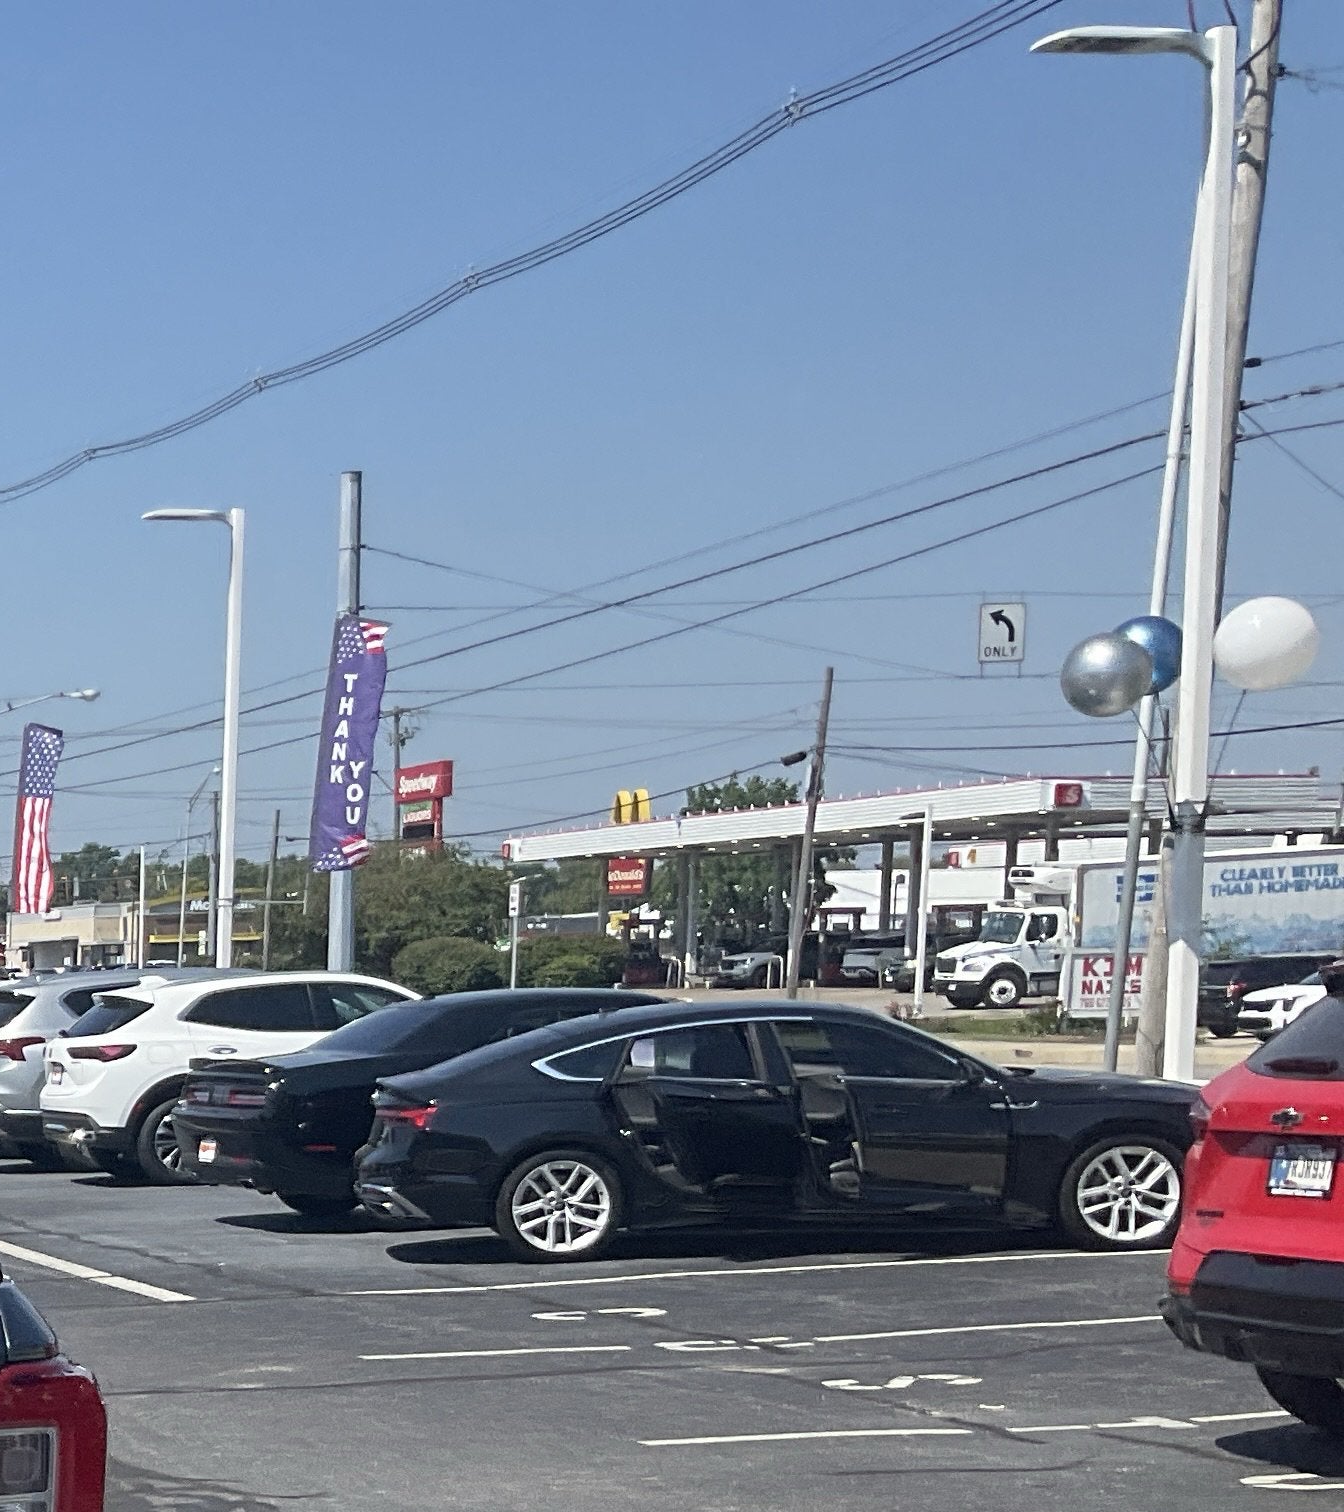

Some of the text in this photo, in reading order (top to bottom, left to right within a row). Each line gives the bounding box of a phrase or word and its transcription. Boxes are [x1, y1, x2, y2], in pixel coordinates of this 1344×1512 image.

[984, 646, 1017, 657] ONLY
[330, 673, 358, 783] THANK
[346, 761, 366, 825] YOU
[1210, 882, 1254, 898] THAN
